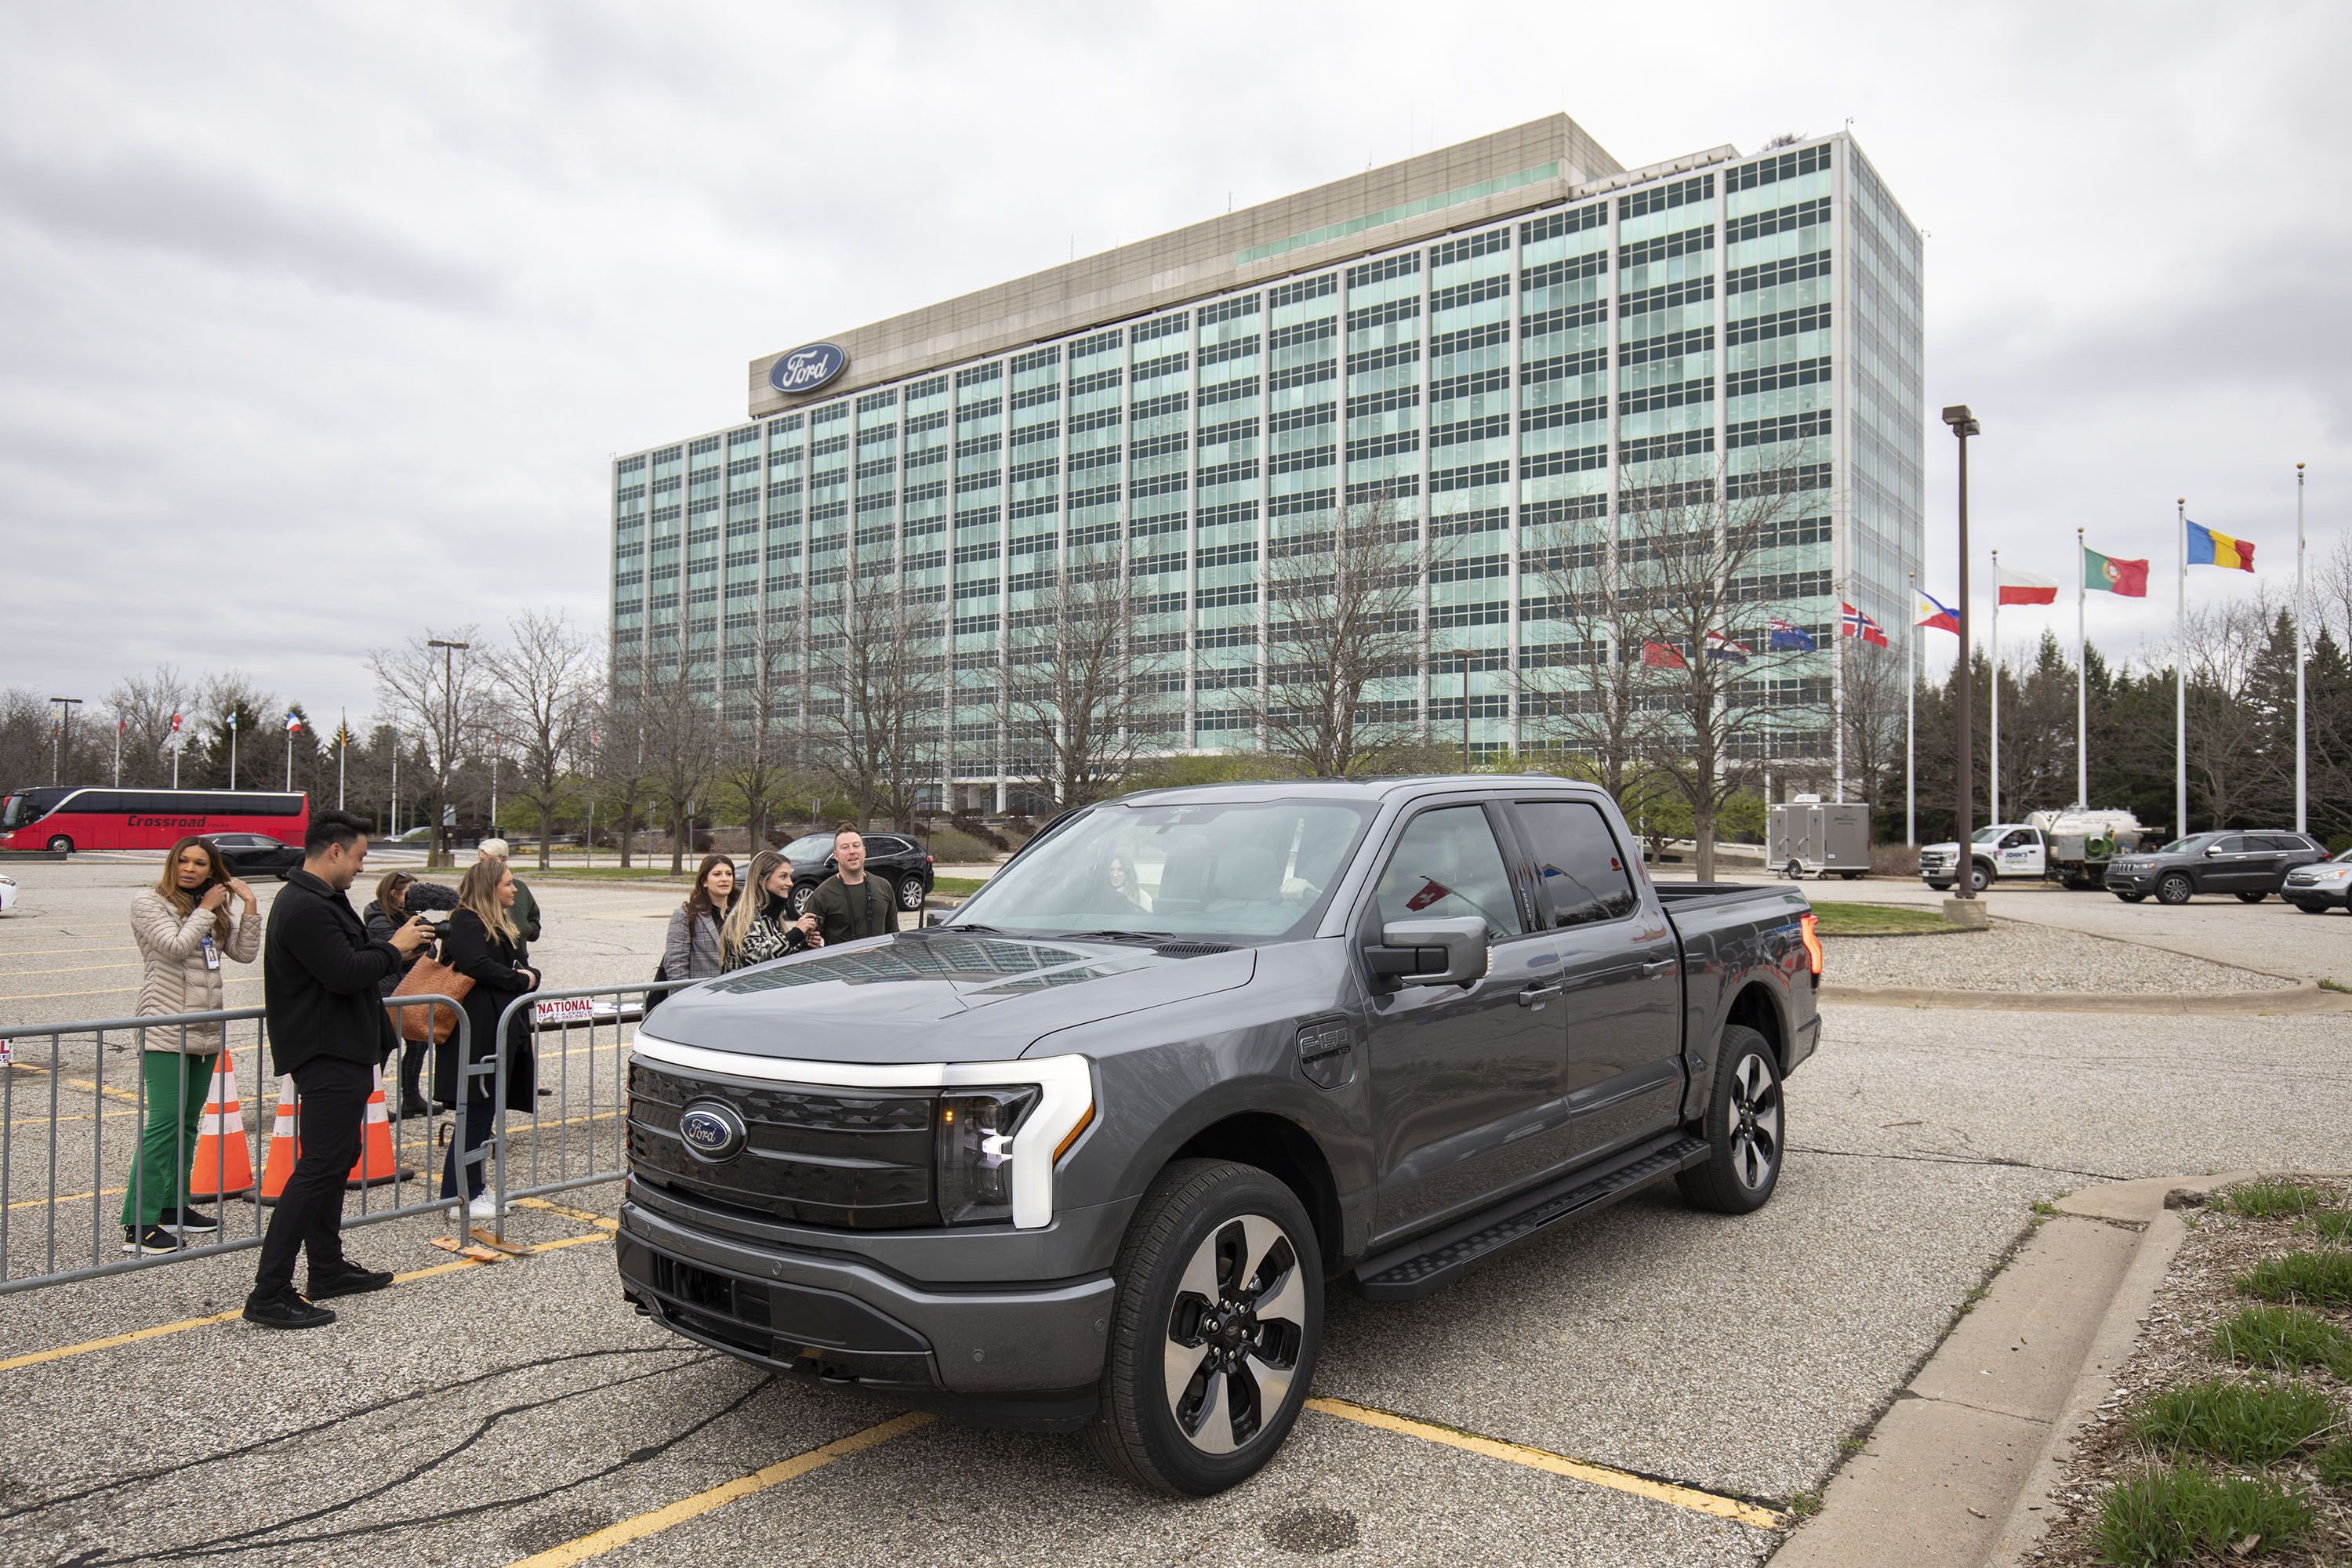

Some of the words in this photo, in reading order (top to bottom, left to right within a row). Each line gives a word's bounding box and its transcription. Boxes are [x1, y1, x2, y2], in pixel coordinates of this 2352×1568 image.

[782, 350, 829, 387] Ford
[127, 815, 207, 827] Crossroad
[539, 1000, 593, 1014] NATIONAL
[1300, 1026, 1349, 1054] F-150
[688, 1119, 717, 1142] Ford
